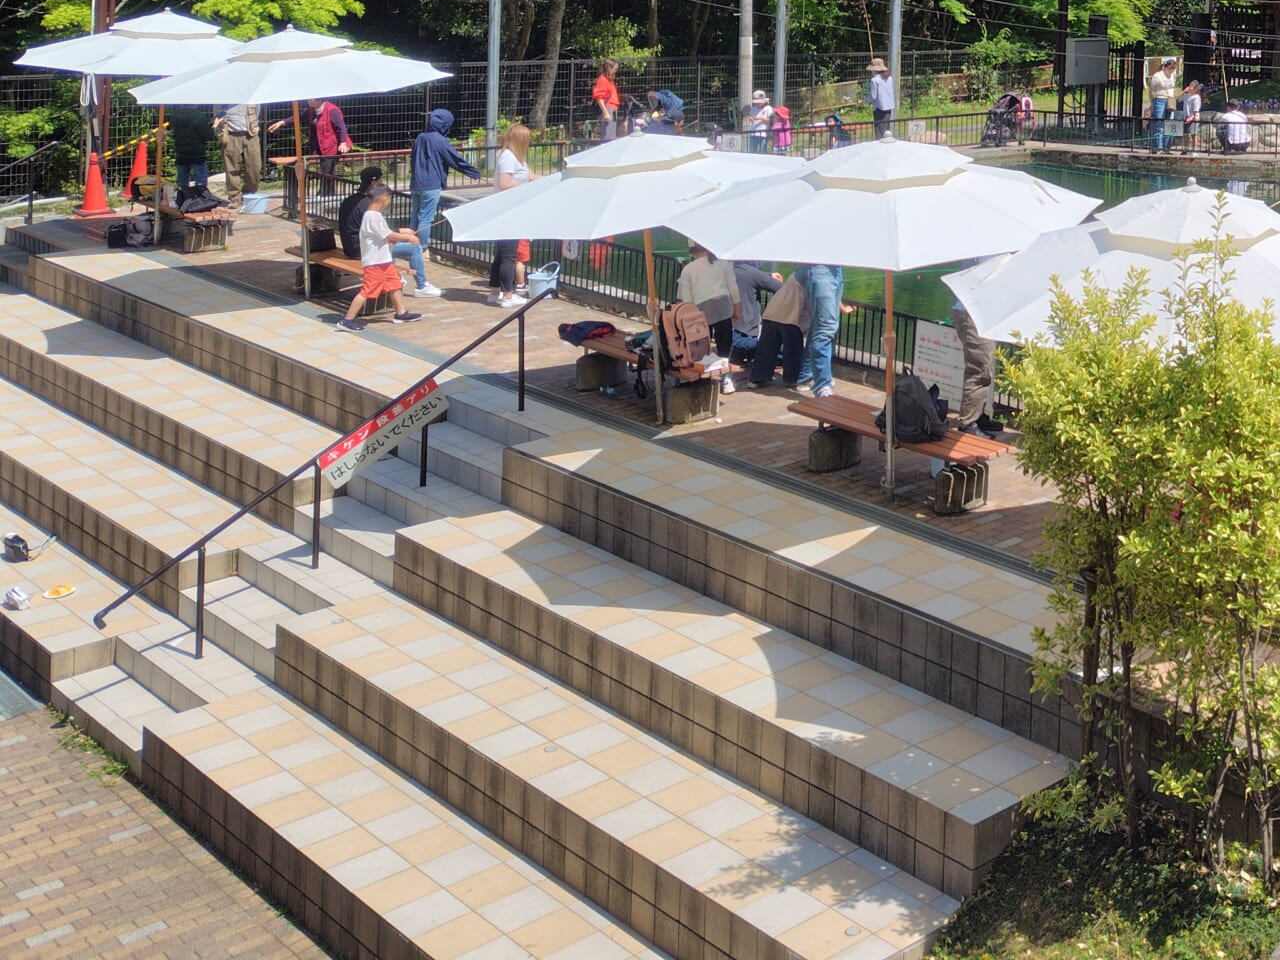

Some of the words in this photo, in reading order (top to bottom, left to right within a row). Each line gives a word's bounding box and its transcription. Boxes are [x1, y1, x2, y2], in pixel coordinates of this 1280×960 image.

[330, 396, 443, 481] はしらないでください
